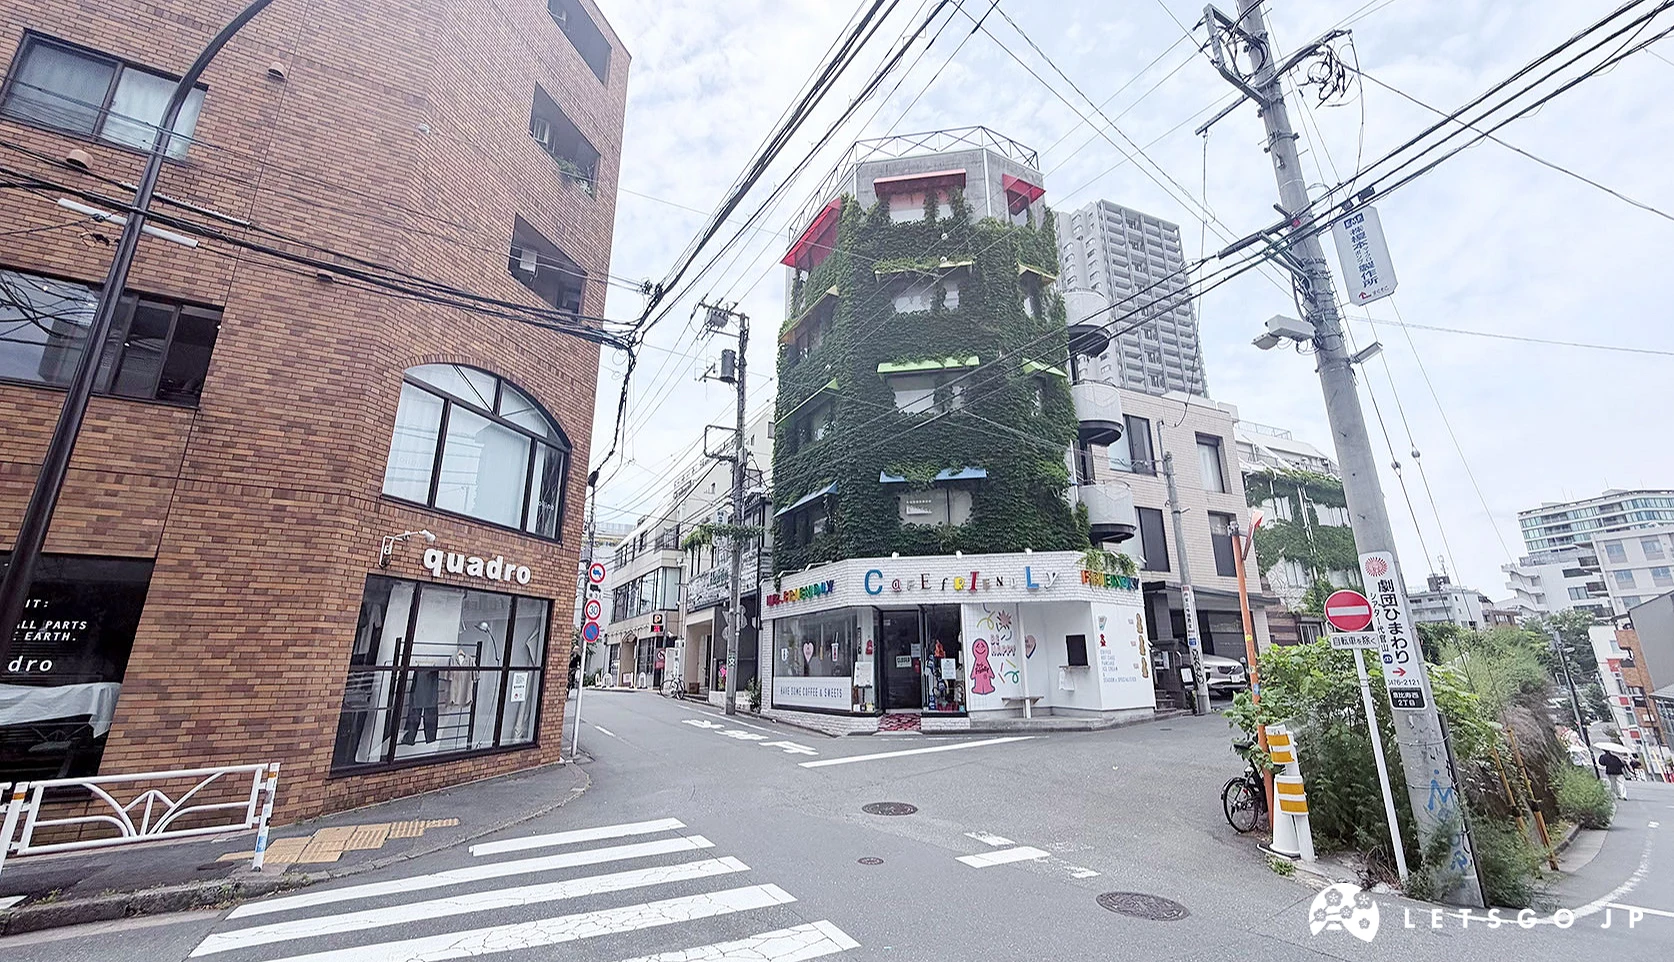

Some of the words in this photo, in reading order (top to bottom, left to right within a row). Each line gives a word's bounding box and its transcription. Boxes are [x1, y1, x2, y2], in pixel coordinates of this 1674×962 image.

[423, 548, 531, 585] quadro
[588, 605, 598, 616] 30
[45, 620, 88, 630] PARTS
[1370, 592, 1390, 652] シアター代官山
[1377, 579, 1410, 664] 劇団ひまわり
[24, 631, 77, 642] EARTH.
[1333, 635, 1377, 648] 自転車を除く
[7, 655, 53, 672] dro
[802, 687, 818, 697] COFFEE
[824, 688, 842, 698] SWEETS
